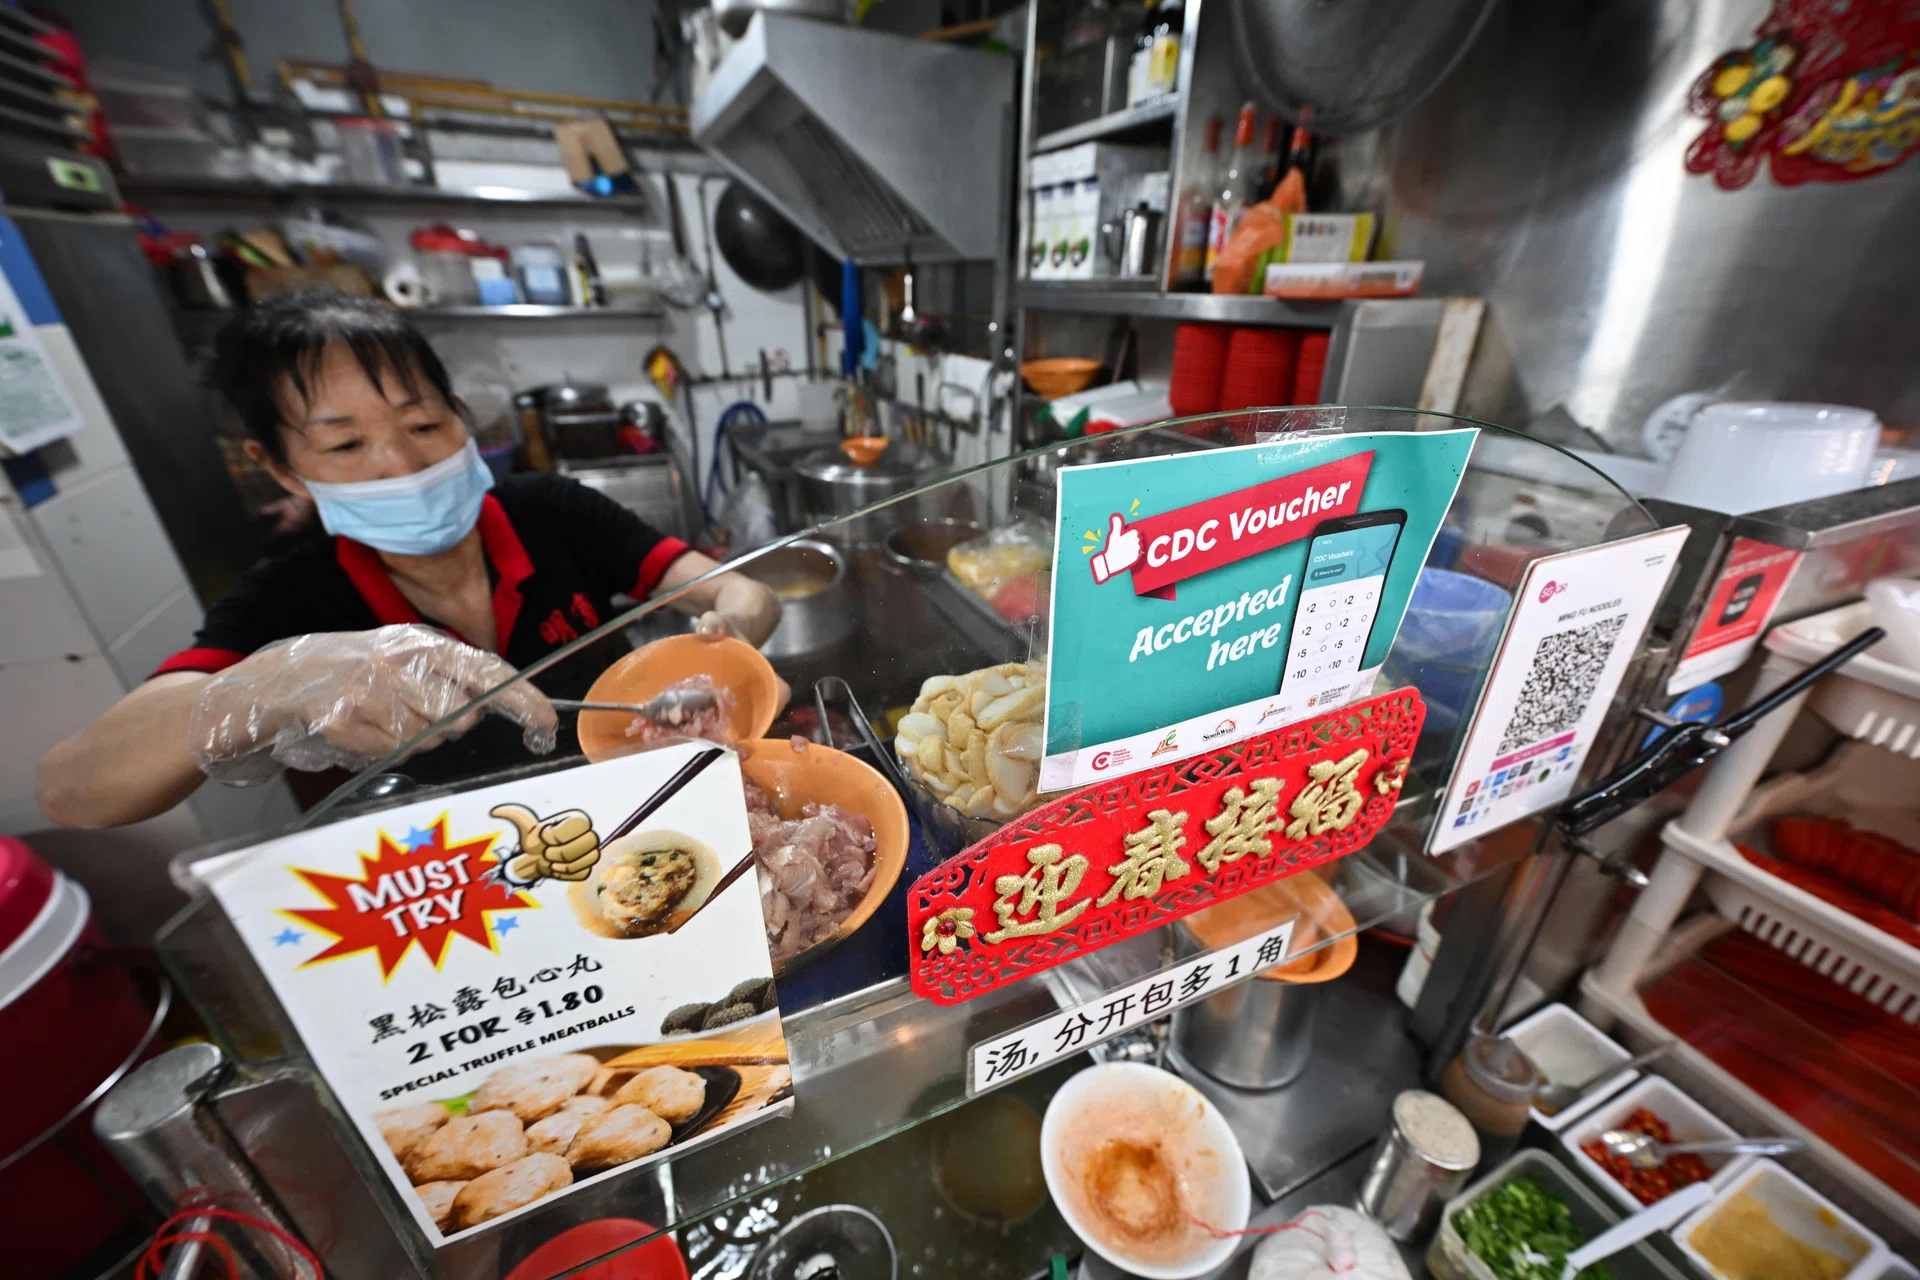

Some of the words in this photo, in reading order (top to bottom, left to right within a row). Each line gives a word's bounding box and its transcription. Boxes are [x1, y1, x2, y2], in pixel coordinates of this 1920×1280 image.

[1147, 519, 1220, 568] CDC
[1229, 480, 1352, 541] Voucher
[1314, 554, 1327, 563] CDC
[1328, 550, 1354, 560] Vouchers
[1129, 574, 1292, 662] Accepted
[1302, 626, 1312, 636] $2
[1339, 618, 1349, 628] $2
[1306, 603, 1317, 613] $2
[1344, 595, 1354, 605] $2
[1558, 611, 1577, 622] MING
[1578, 608, 1588, 617] FU
[1589, 598, 1622, 613] NOODLES
[1206, 622, 1281, 671] here
[1292, 669, 1307, 679] $10
[1328, 660, 1342, 669] $10
[1297, 648, 1307, 658] $5
[1333, 640, 1344, 649] $5
[984, 747, 1369, 944] 迎春接福
[345, 853, 473, 913] MUST
[381, 889, 465, 937] TRY
[406, 1041, 434, 1065] 2
[439, 1016, 510, 1052] FOR
[514, 984, 604, 1026] $1.80
[379, 1068, 460, 1101] SPECIAL
[462, 1039, 537, 1072] TRUFFLE
[540, 1005, 637, 1046] MEATBALLS
